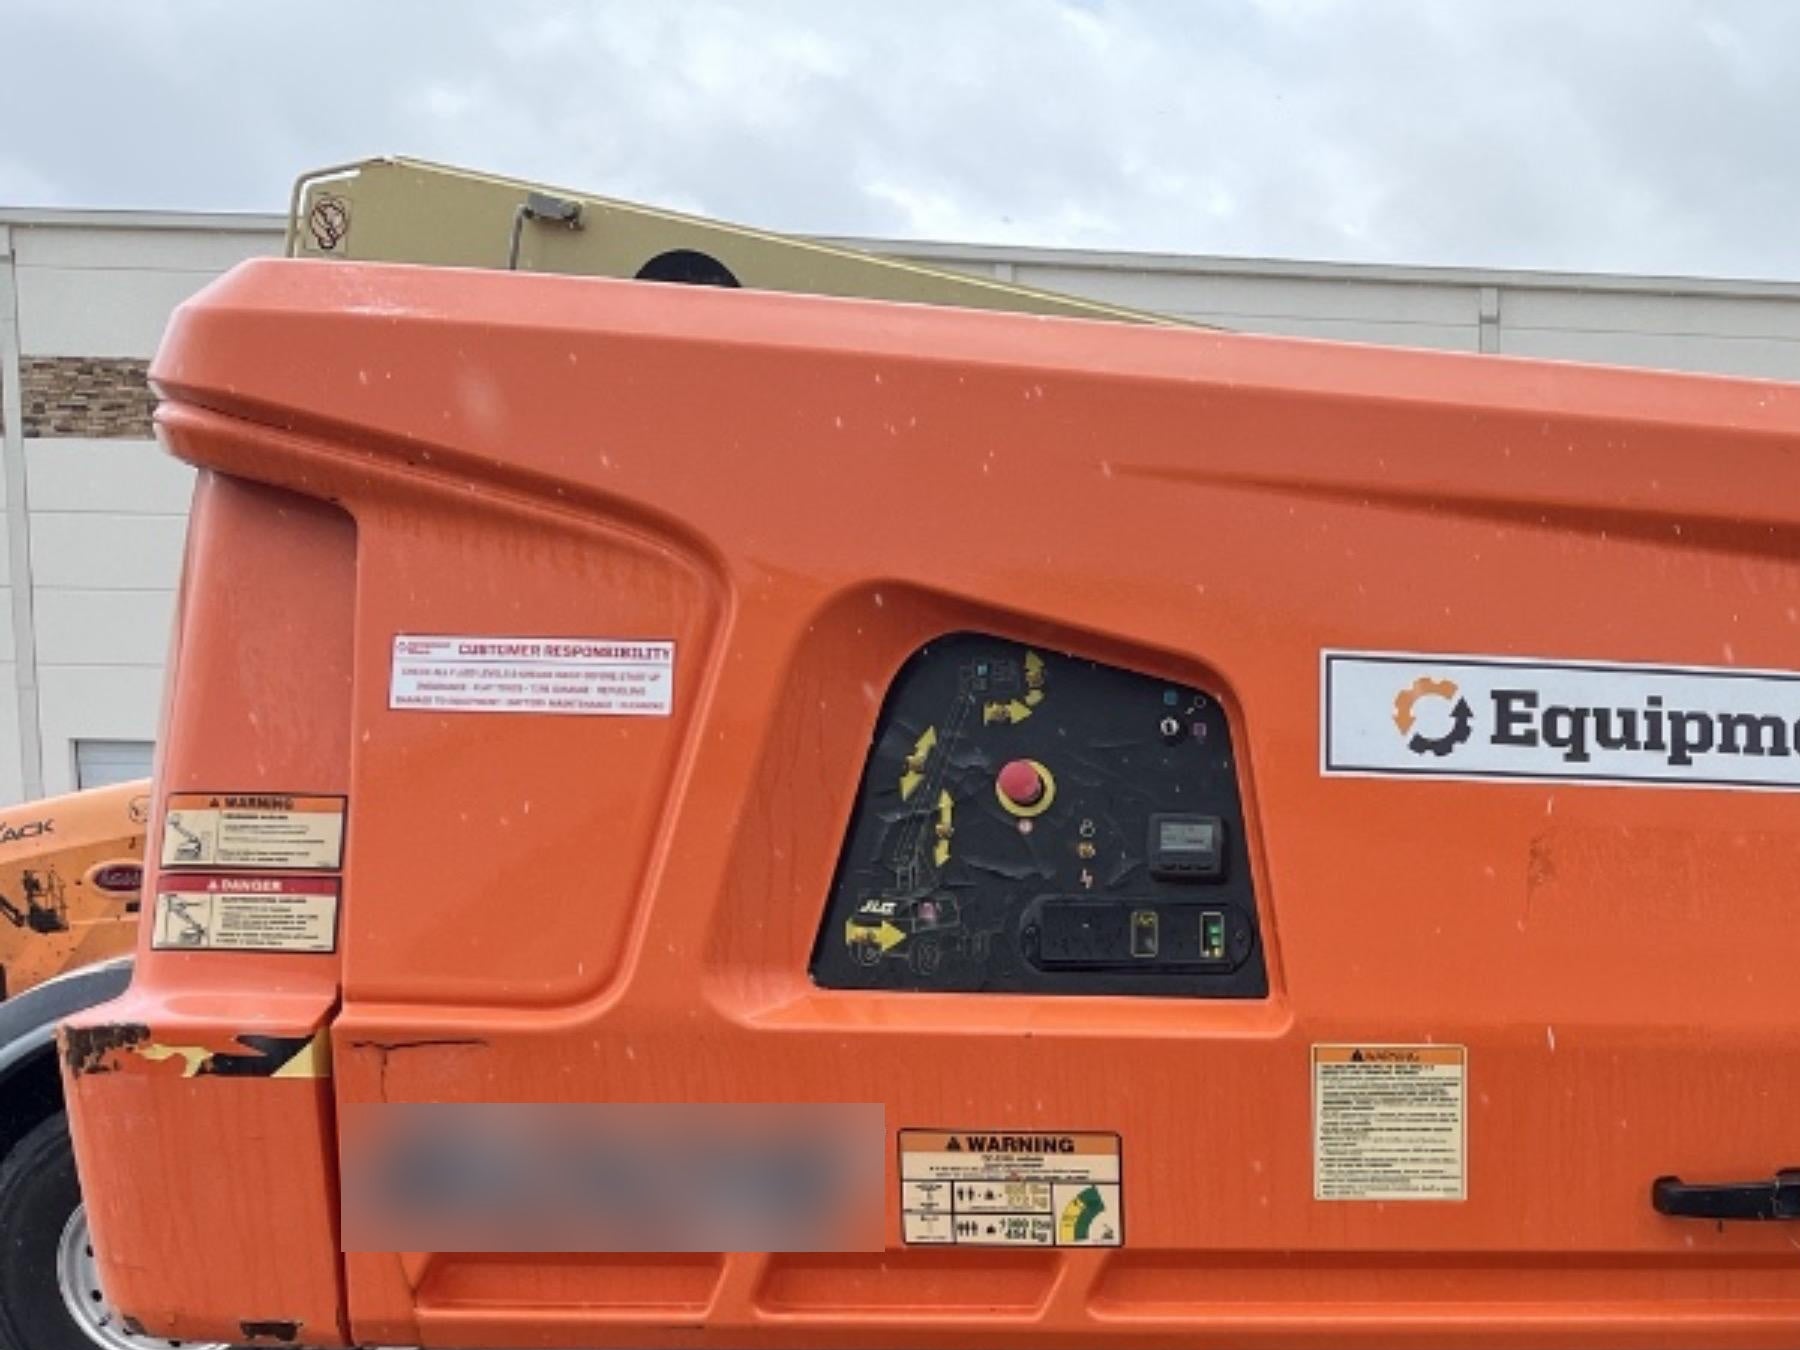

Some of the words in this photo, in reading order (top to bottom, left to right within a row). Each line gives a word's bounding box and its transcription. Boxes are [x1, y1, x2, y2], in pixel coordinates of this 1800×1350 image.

[224, 797, 295, 811] WARNING
[221, 879, 283, 892] DANGER
[967, 1136, 1075, 1153] WARNING
